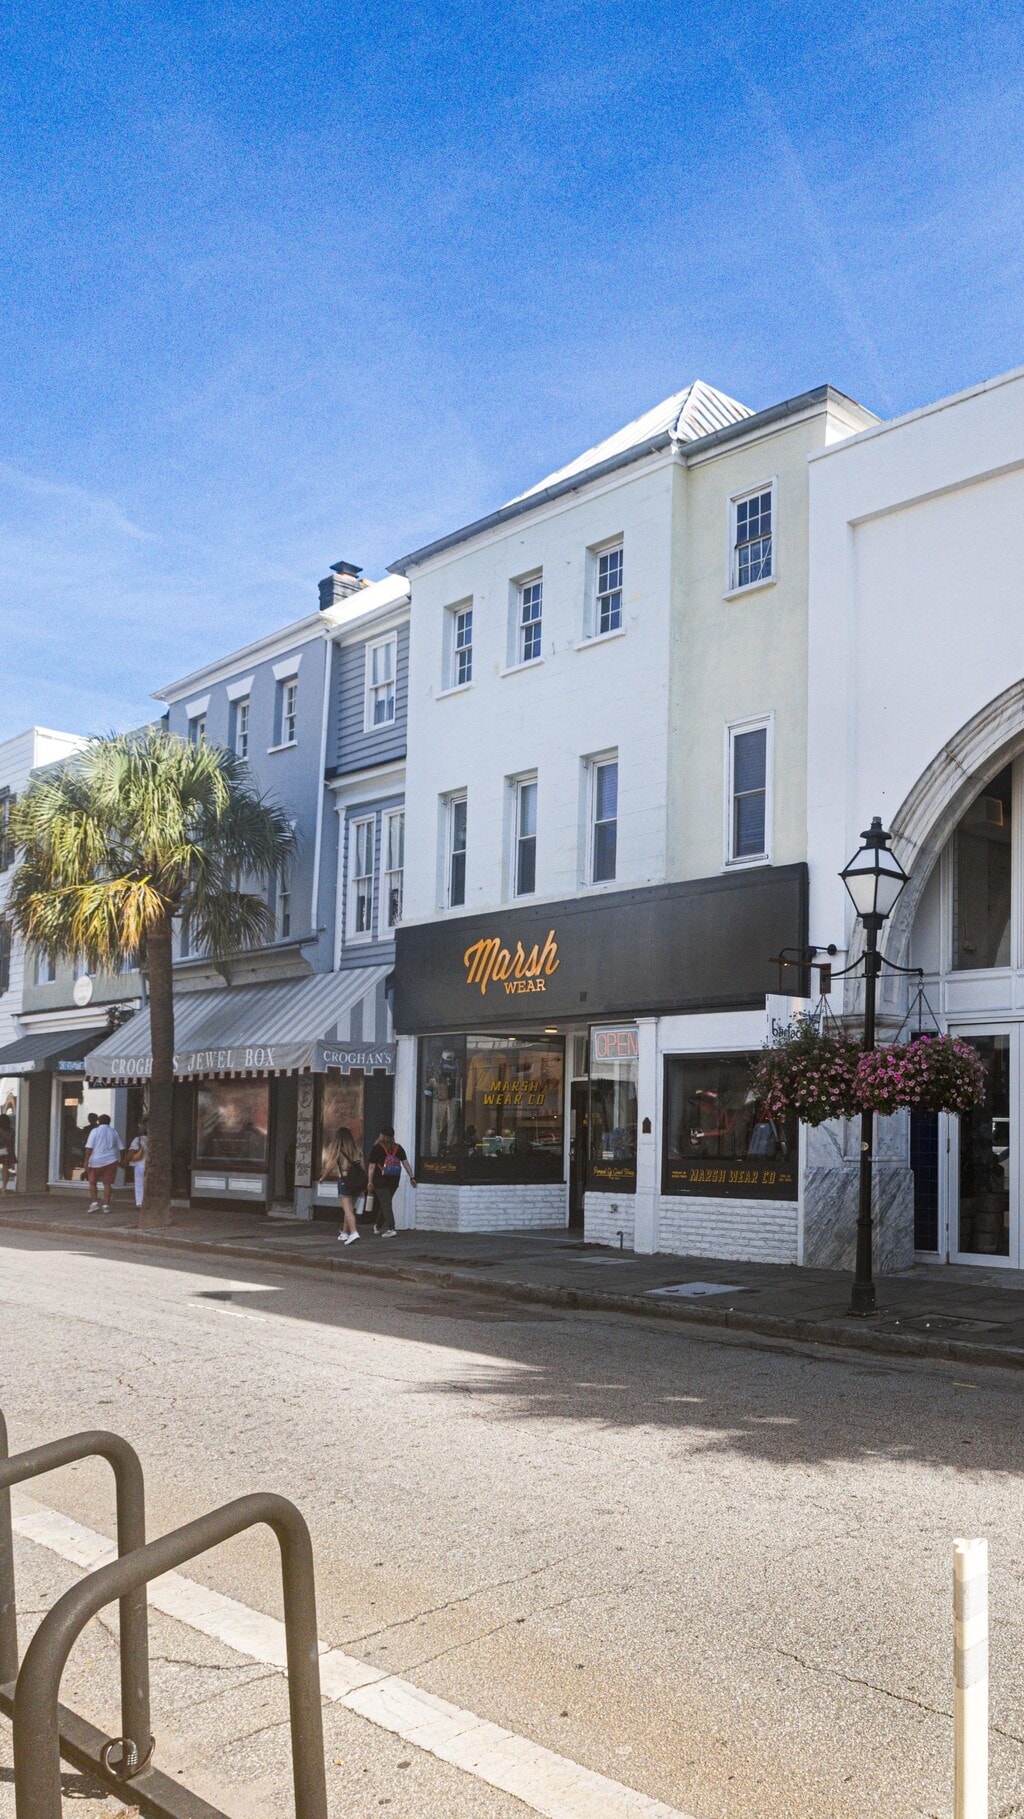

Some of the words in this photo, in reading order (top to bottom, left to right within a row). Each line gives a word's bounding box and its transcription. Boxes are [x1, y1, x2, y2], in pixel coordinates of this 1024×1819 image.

[463, 929, 560, 995] Marsh
[503, 978, 547, 995] WEAR
[597, 1031, 639, 1057] OPEN
[188, 1050, 234, 1071] JEWEL
[245, 1047, 275, 1067] BOX
[323, 1050, 392, 1064] CROGHAN'S
[490, 1080, 540, 1093] MARSH
[483, 1093, 523, 1106] WEAR
[527, 1093, 546, 1106] CO
[689, 1168, 727, 1183] MARSH
[728, 1170, 759, 1184] WEAR
[761, 1171, 777, 1185] CO
